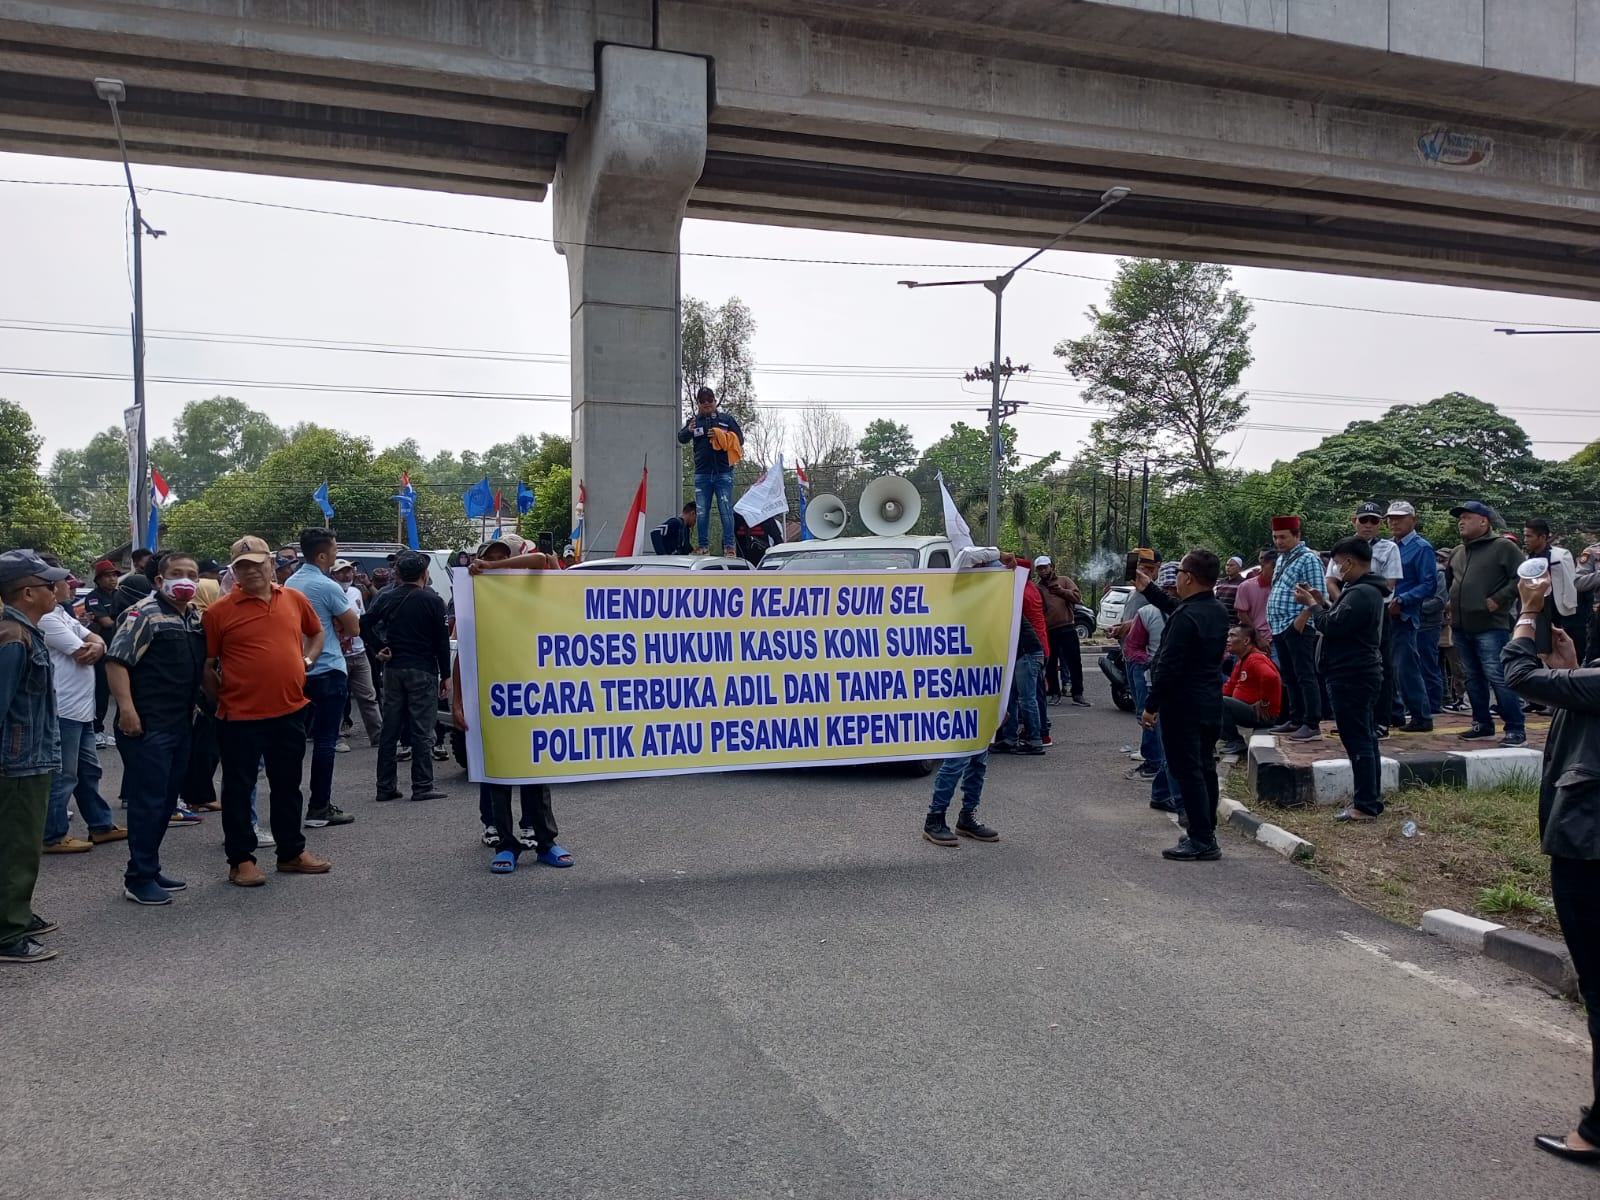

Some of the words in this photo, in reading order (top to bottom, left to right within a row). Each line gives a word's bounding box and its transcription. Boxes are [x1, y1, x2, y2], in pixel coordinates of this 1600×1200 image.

[585, 587, 744, 620] MENDUKUNG
[750, 585, 831, 618] KEJATI
[836, 585, 885, 616] SUM
[889, 585, 930, 615] SEL
[537, 633, 637, 668] PROSES
[644, 630, 733, 665] HUKUM
[739, 629, 818, 662] KASUS
[823, 627, 880, 660] KONI
[885, 625, 973, 657] SUMSEL
[490, 679, 595, 717] SECARA
[599, 676, 718, 712] TERBUKA
[723, 673, 778, 707] ADIL
[783, 672, 830, 704] DAN
[835, 669, 908, 702] TANPA
[913, 665, 1003, 699] PESANAN
[532, 725, 635, 764] POLITIK
[641, 722, 703, 757] ATAU
[710, 716, 819, 753] PESANAN
[826, 708, 978, 747] KEPENTINGAN
